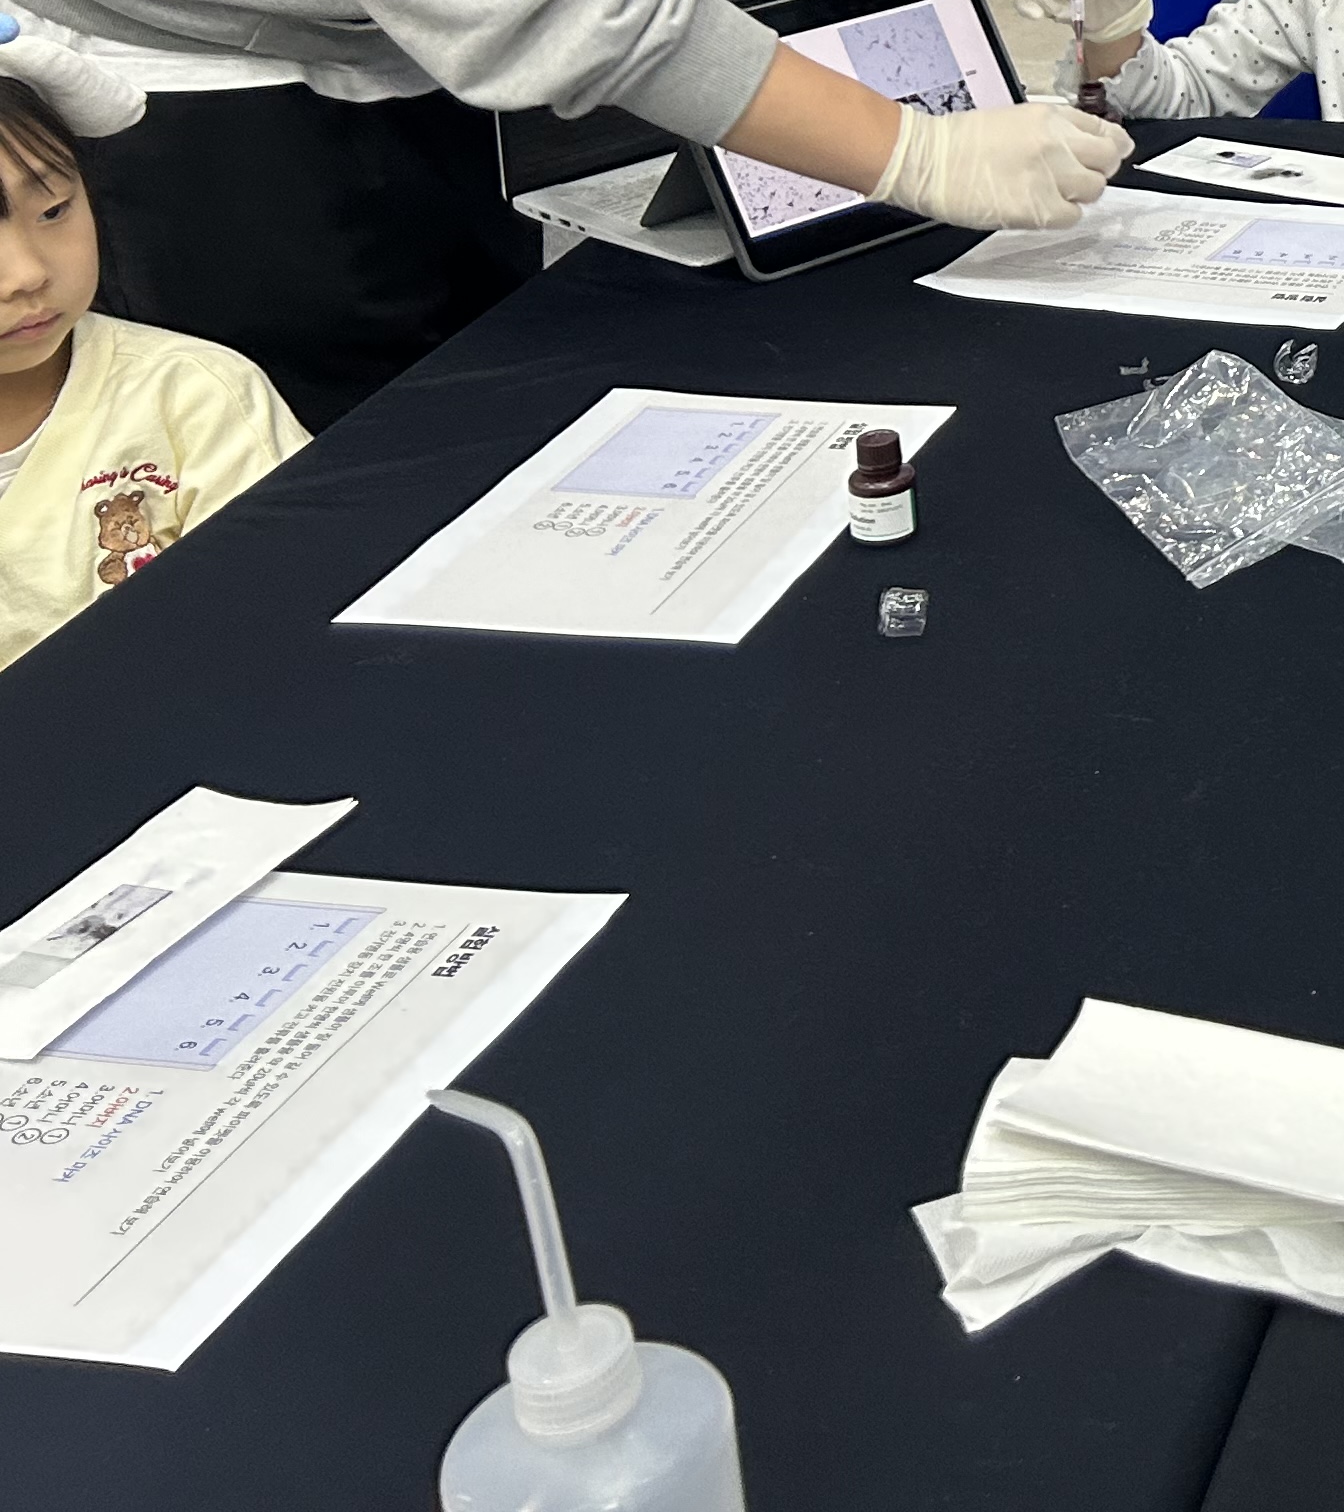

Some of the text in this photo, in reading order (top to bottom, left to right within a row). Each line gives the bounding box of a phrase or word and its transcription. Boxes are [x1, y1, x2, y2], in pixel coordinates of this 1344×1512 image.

[429, 926, 504, 976] 실험 방법
[116, 1101, 153, 1125] DNA
[80, 1128, 122, 1159] 사이즈
[52, 1161, 87, 1182] 마커
[160, 1149, 213, 1183] 이용하여
[107, 1217, 142, 1234] 보기
